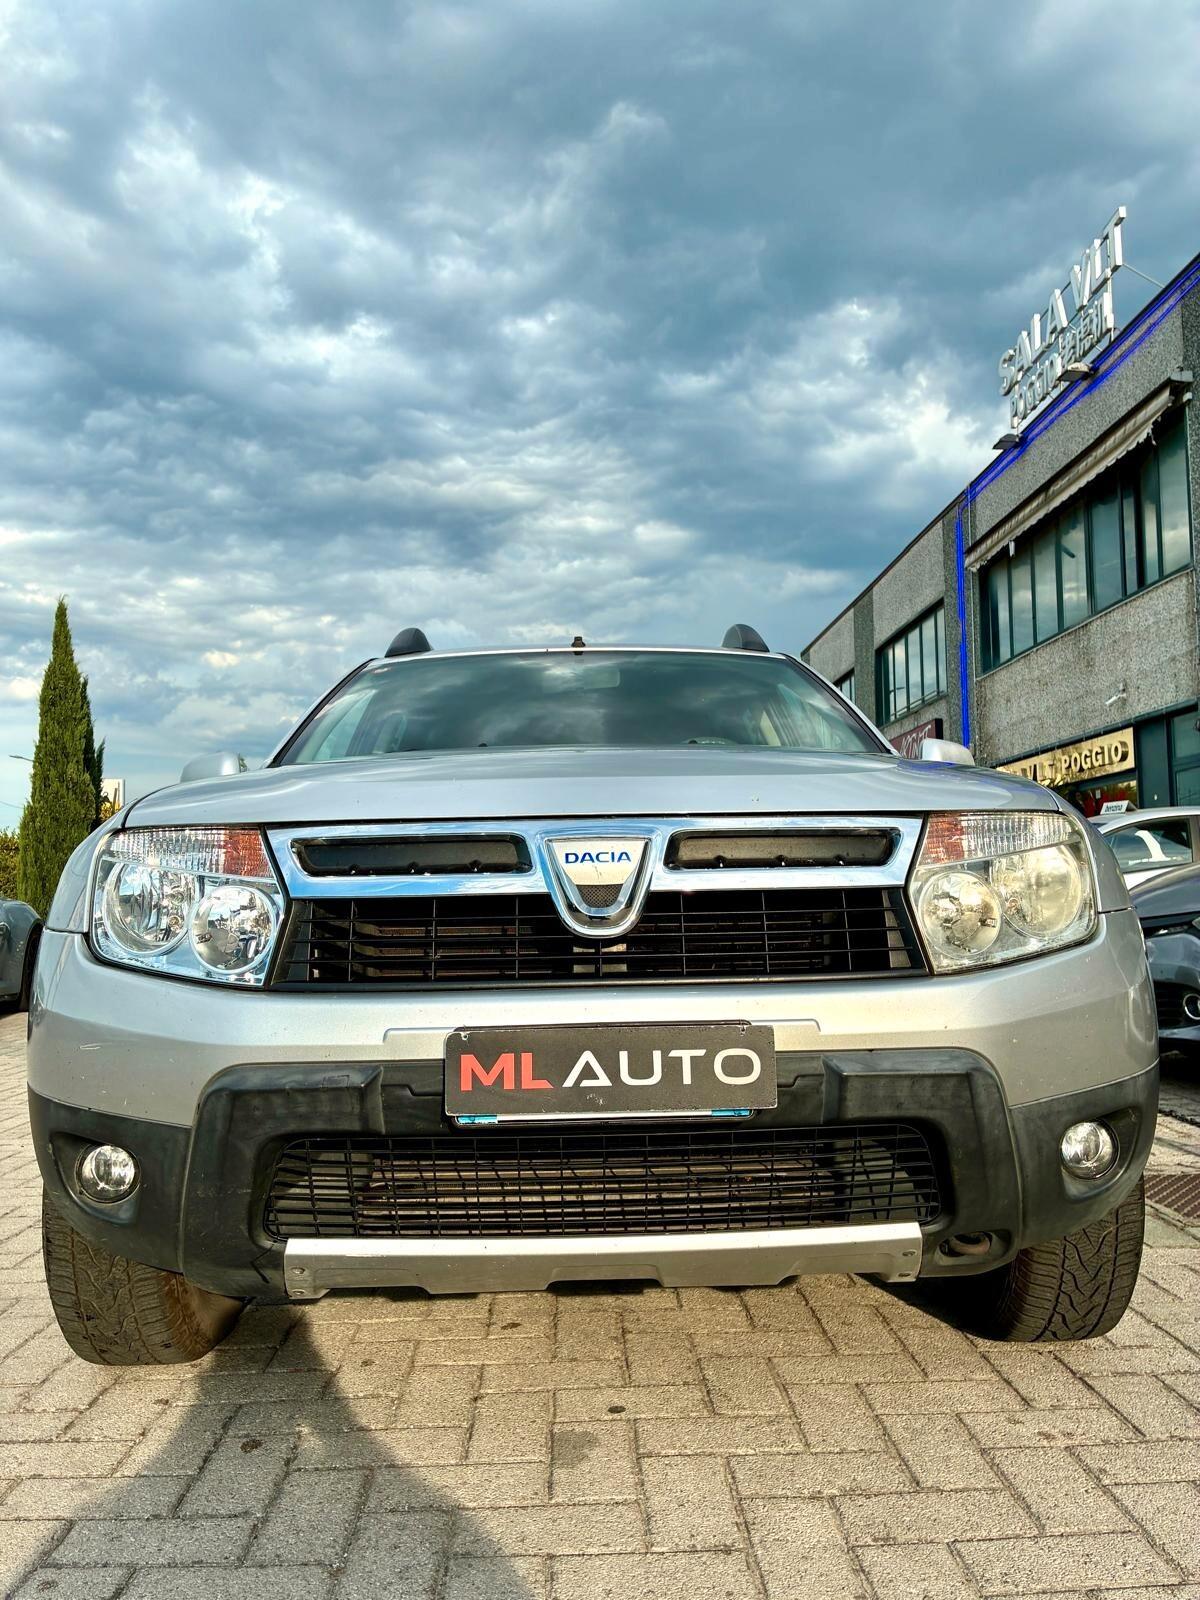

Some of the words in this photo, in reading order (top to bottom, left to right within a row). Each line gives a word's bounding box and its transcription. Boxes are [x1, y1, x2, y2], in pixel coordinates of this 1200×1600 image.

[999, 289, 1067, 396] SALA
[1069, 206, 1126, 311] VLT
[1010, 353, 1062, 428] POGGIO
[1061, 741, 1126, 773] POGGIO
[565, 851, 631, 864] DACIA
[460, 1052, 554, 1092] ML
[562, 1048, 761, 1087] AUTO
